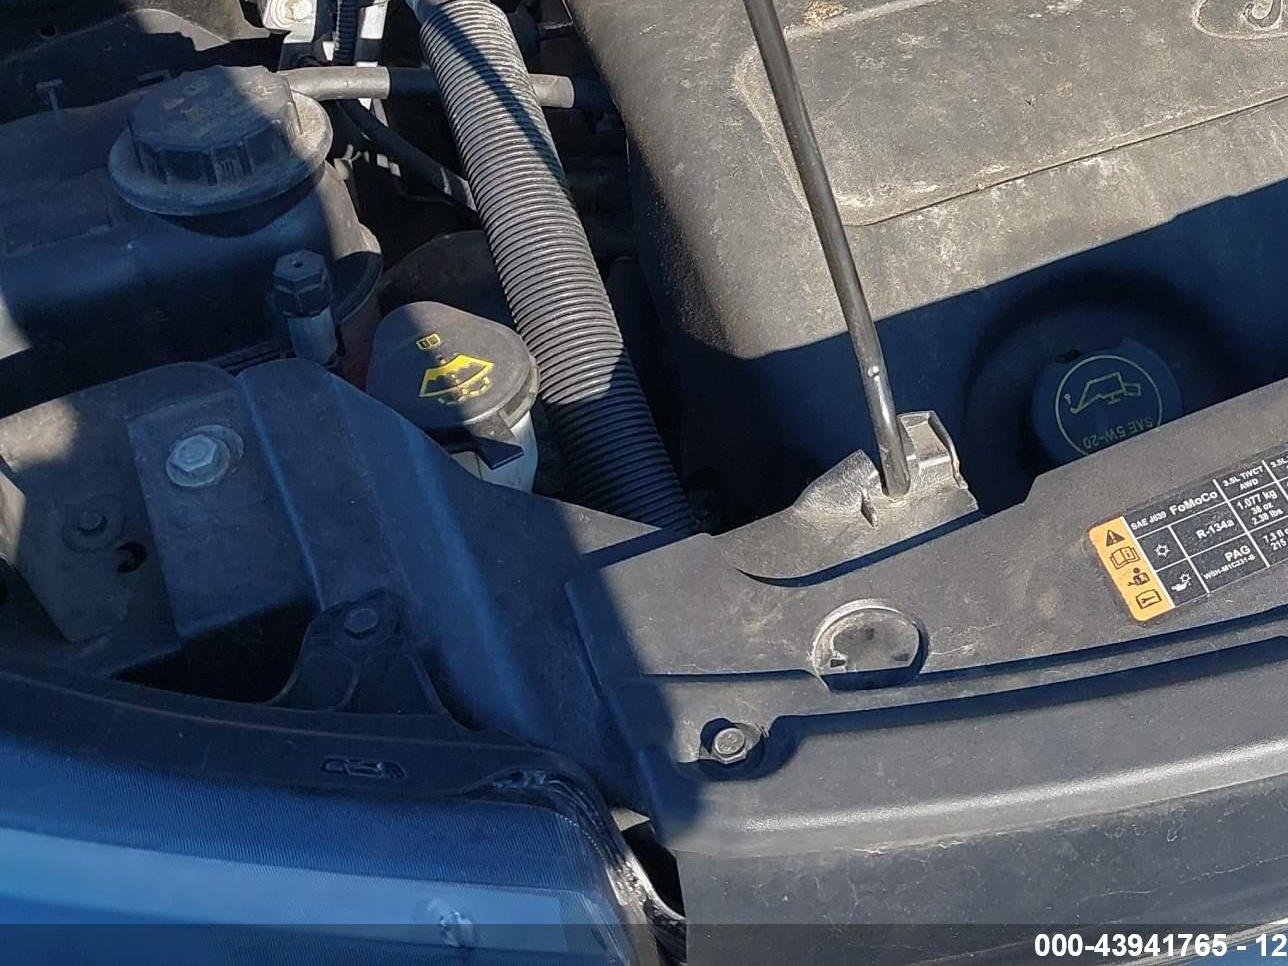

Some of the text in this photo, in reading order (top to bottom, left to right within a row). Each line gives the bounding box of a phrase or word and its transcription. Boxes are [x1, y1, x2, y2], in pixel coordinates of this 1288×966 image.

[1082, 416, 1153, 450] SAE 5W-20
[1270, 457, 1288, 468] 3.5L
[1222, 475, 1241, 487] 3.5L
[1239, 478, 1259, 491] AWD
[1237, 489, 1278, 510] 1.077 kg
[1130, 490, 1218, 531] SAE J639 FoMoCo
[1250, 502, 1274, 515] 38 oz
[1251, 508, 1283, 526] 2.38 lbs
[1195, 519, 1235, 539] R-134a
[1276, 529, 1285, 537] fl
[1270, 537, 1287, 550] 215
[1224, 544, 1251, 562] PAG
